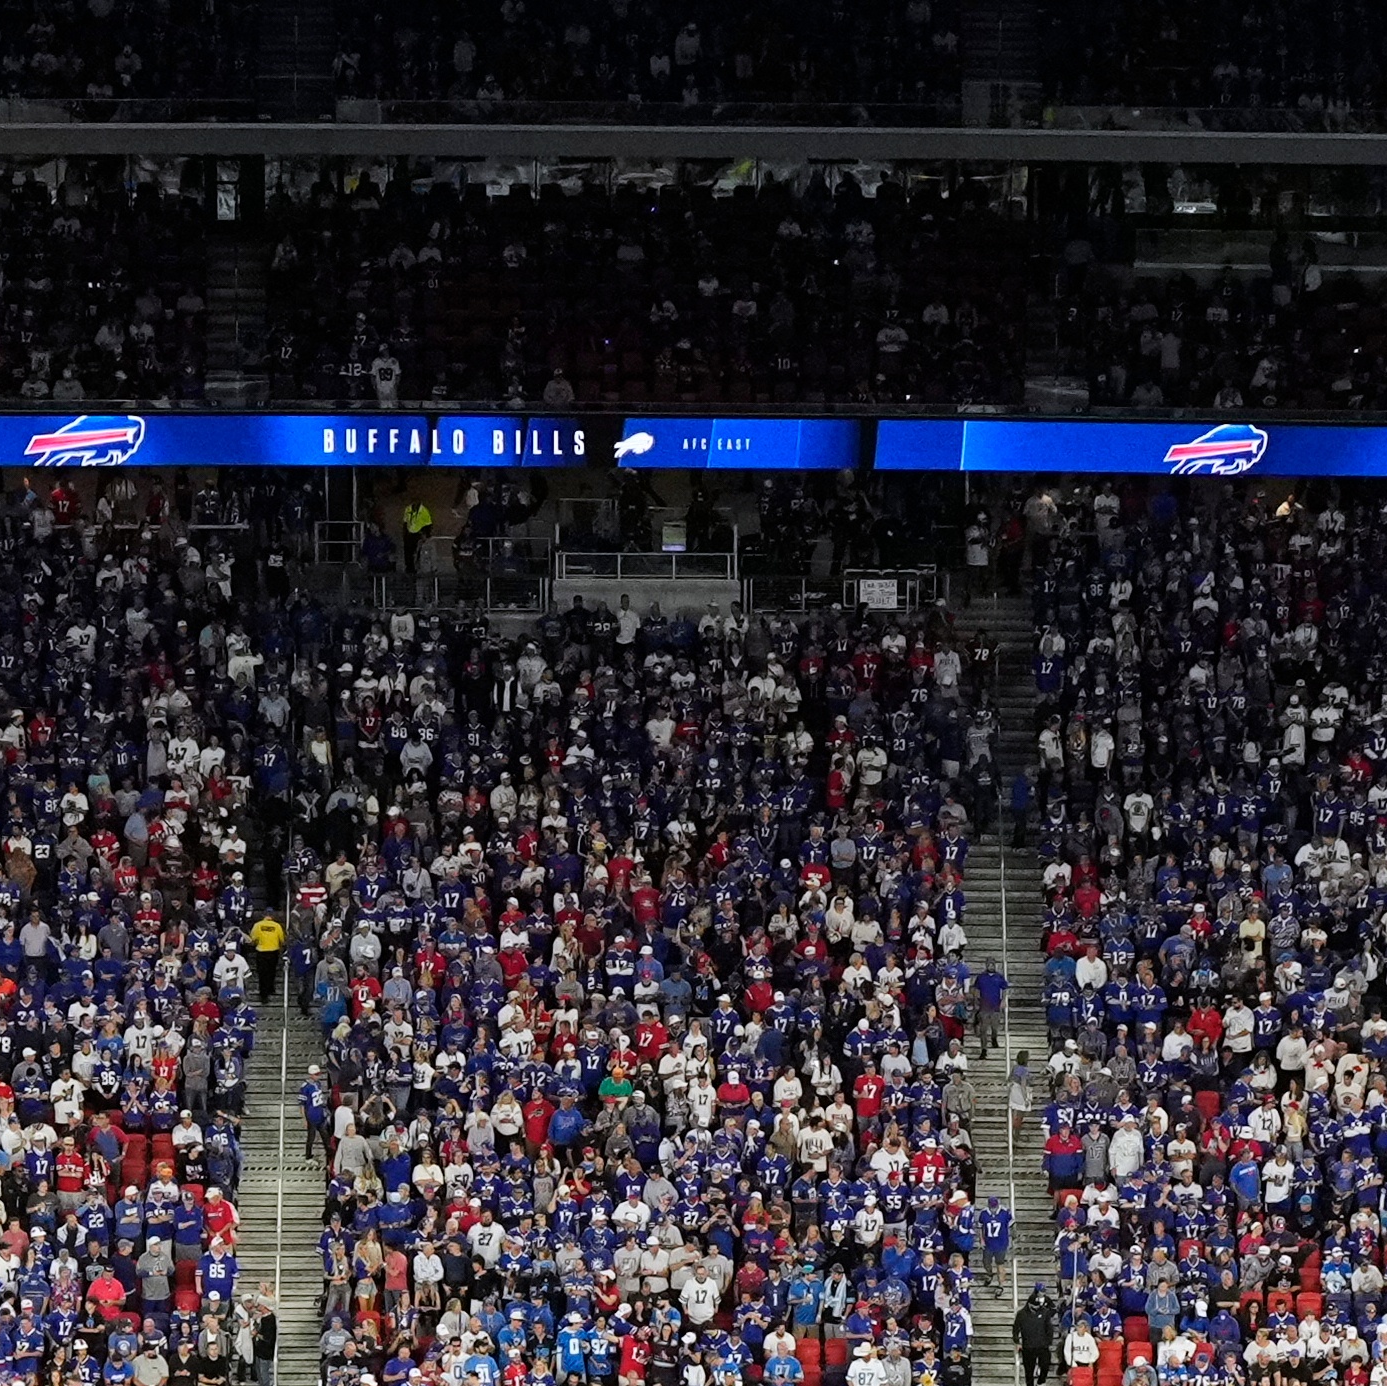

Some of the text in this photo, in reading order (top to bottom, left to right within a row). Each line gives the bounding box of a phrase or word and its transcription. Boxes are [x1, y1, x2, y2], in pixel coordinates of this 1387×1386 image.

[323, 428, 586, 455] BUFFALO BILLS
[682, 438, 752, 451] AFC EAST
[59, 501, 69, 512] 17
[1042, 662, 1053, 674] 17
[264, 754, 275, 766] 17
[783, 797, 793, 810] 17
[445, 893, 459, 907] 17
[587, 1056, 599, 1069] 17
[987, 1222, 1001, 1237] 17
[695, 1290, 707, 1304] 17
